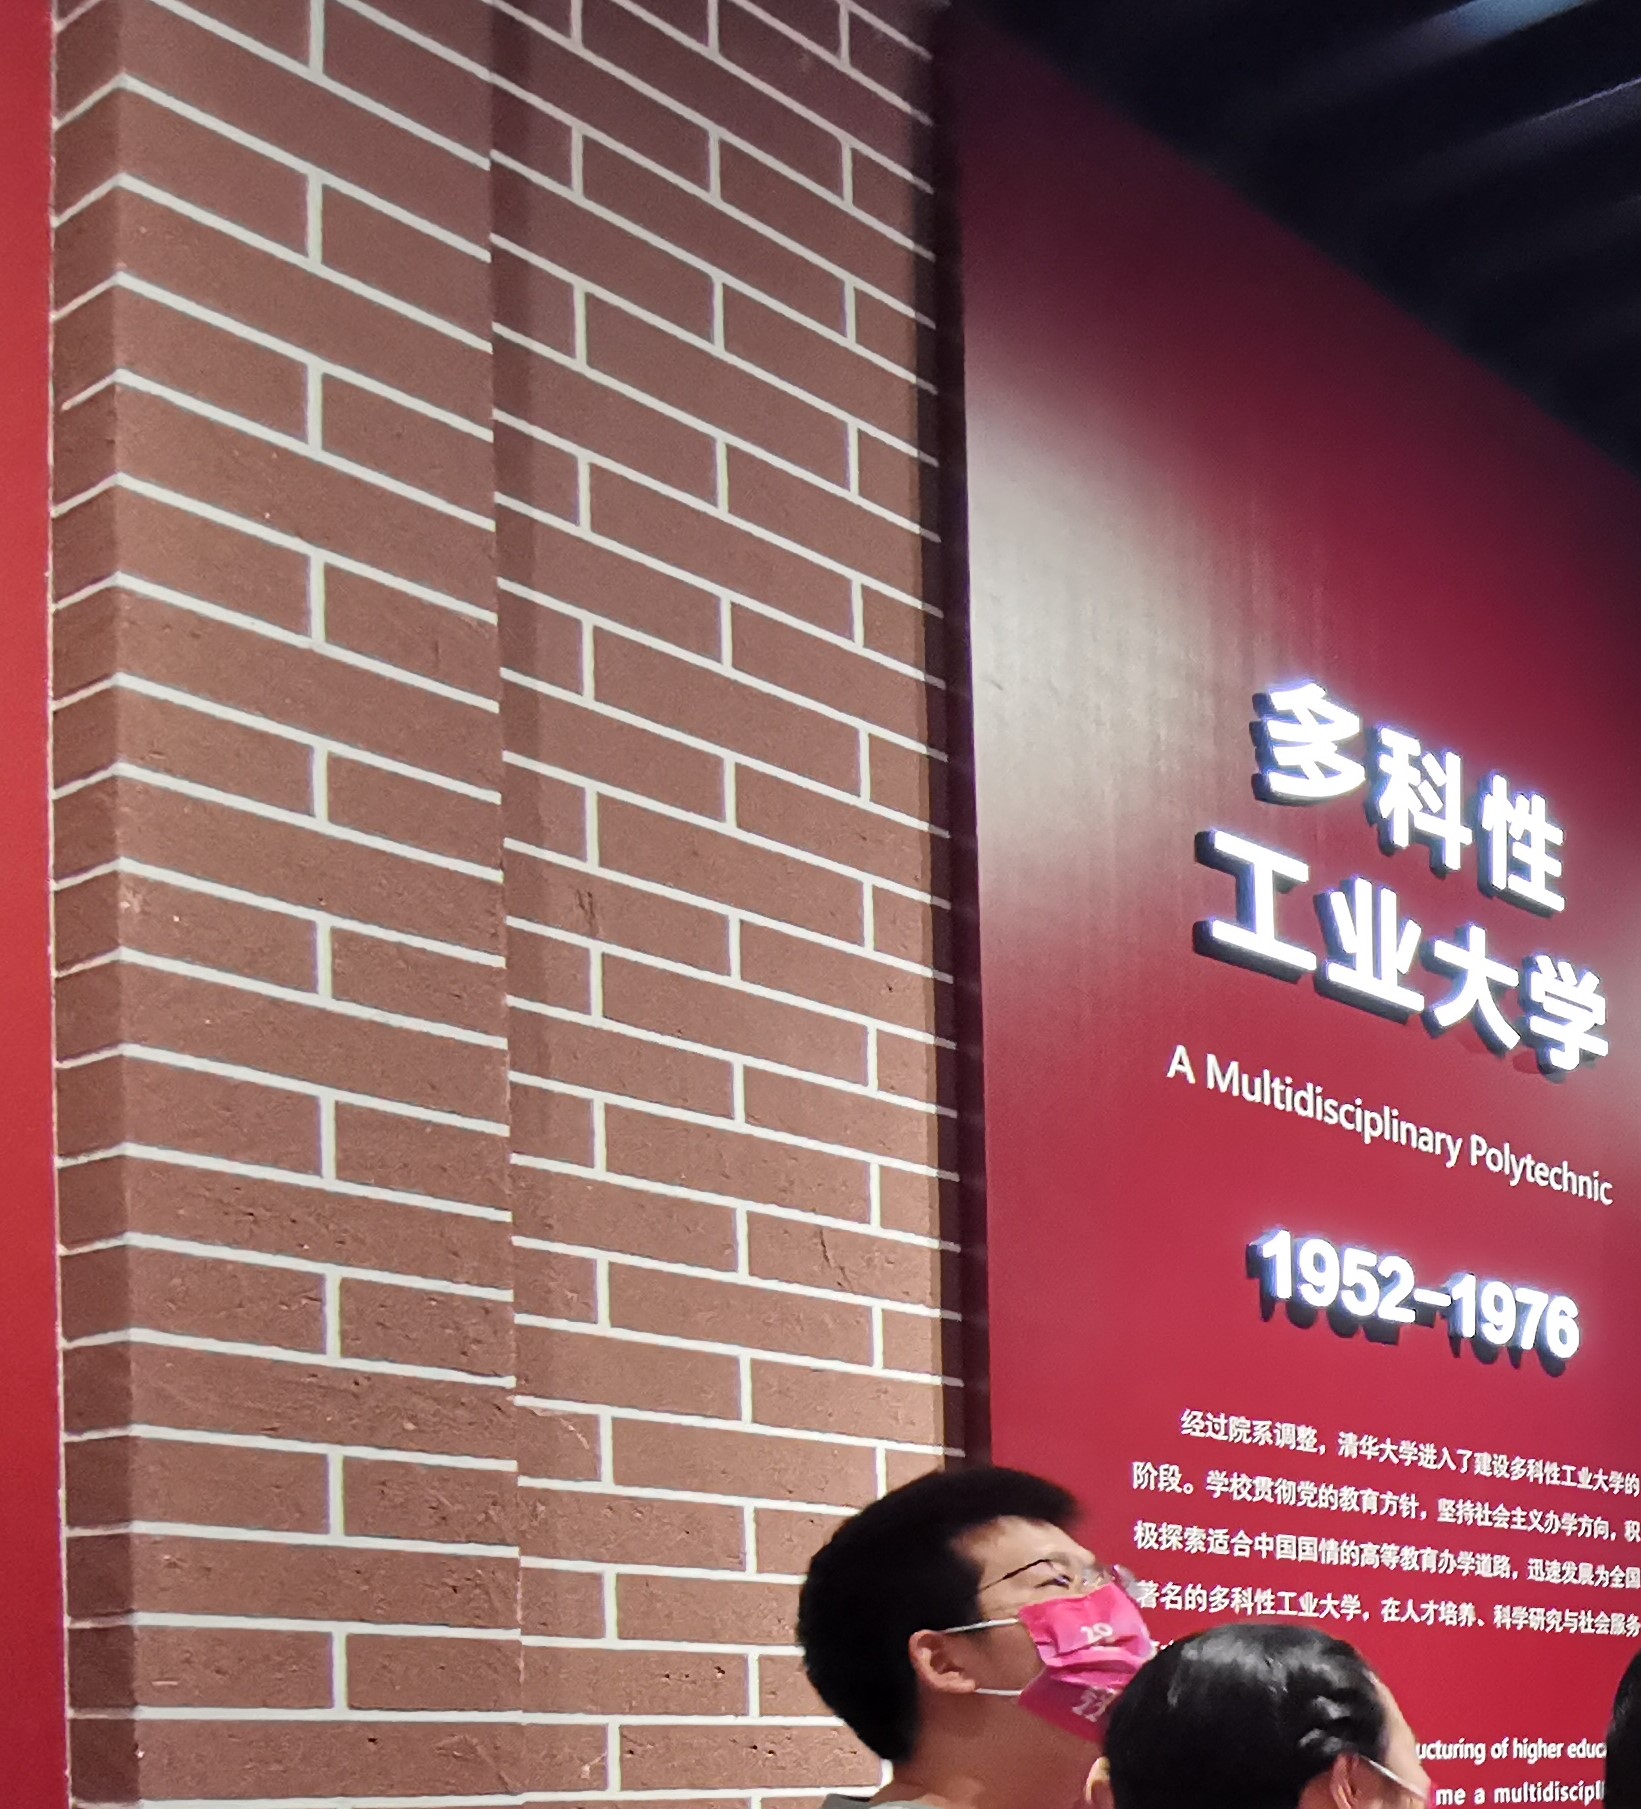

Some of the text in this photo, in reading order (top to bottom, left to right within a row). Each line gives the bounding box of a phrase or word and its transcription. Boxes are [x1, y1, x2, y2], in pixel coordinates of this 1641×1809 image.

[1254, 681, 1565, 914] 多科性
[1198, 828, 1609, 1072] 工业大学
[1167, 1045, 1614, 1207] A Multidisciplinary Polytechnic
[1181, 1408, 1641, 1498] 经过院系调整，清华大学进入了建设多科性工业大学的
[1132, 1461, 1641, 1542] 阶段。学校贯彻党的教育方针，坚持社会主义办学方向，积
[1134, 1520, 1641, 1590] 极探索适合中国国情的高等教育办学道路，迅速发展为全国
[1491, 1737, 1509, 1759] of
[1512, 1738, 1564, 1764] higher
[1567, 1738, 1607, 1759] educ
[1474, 1787, 1486, 1804] a
